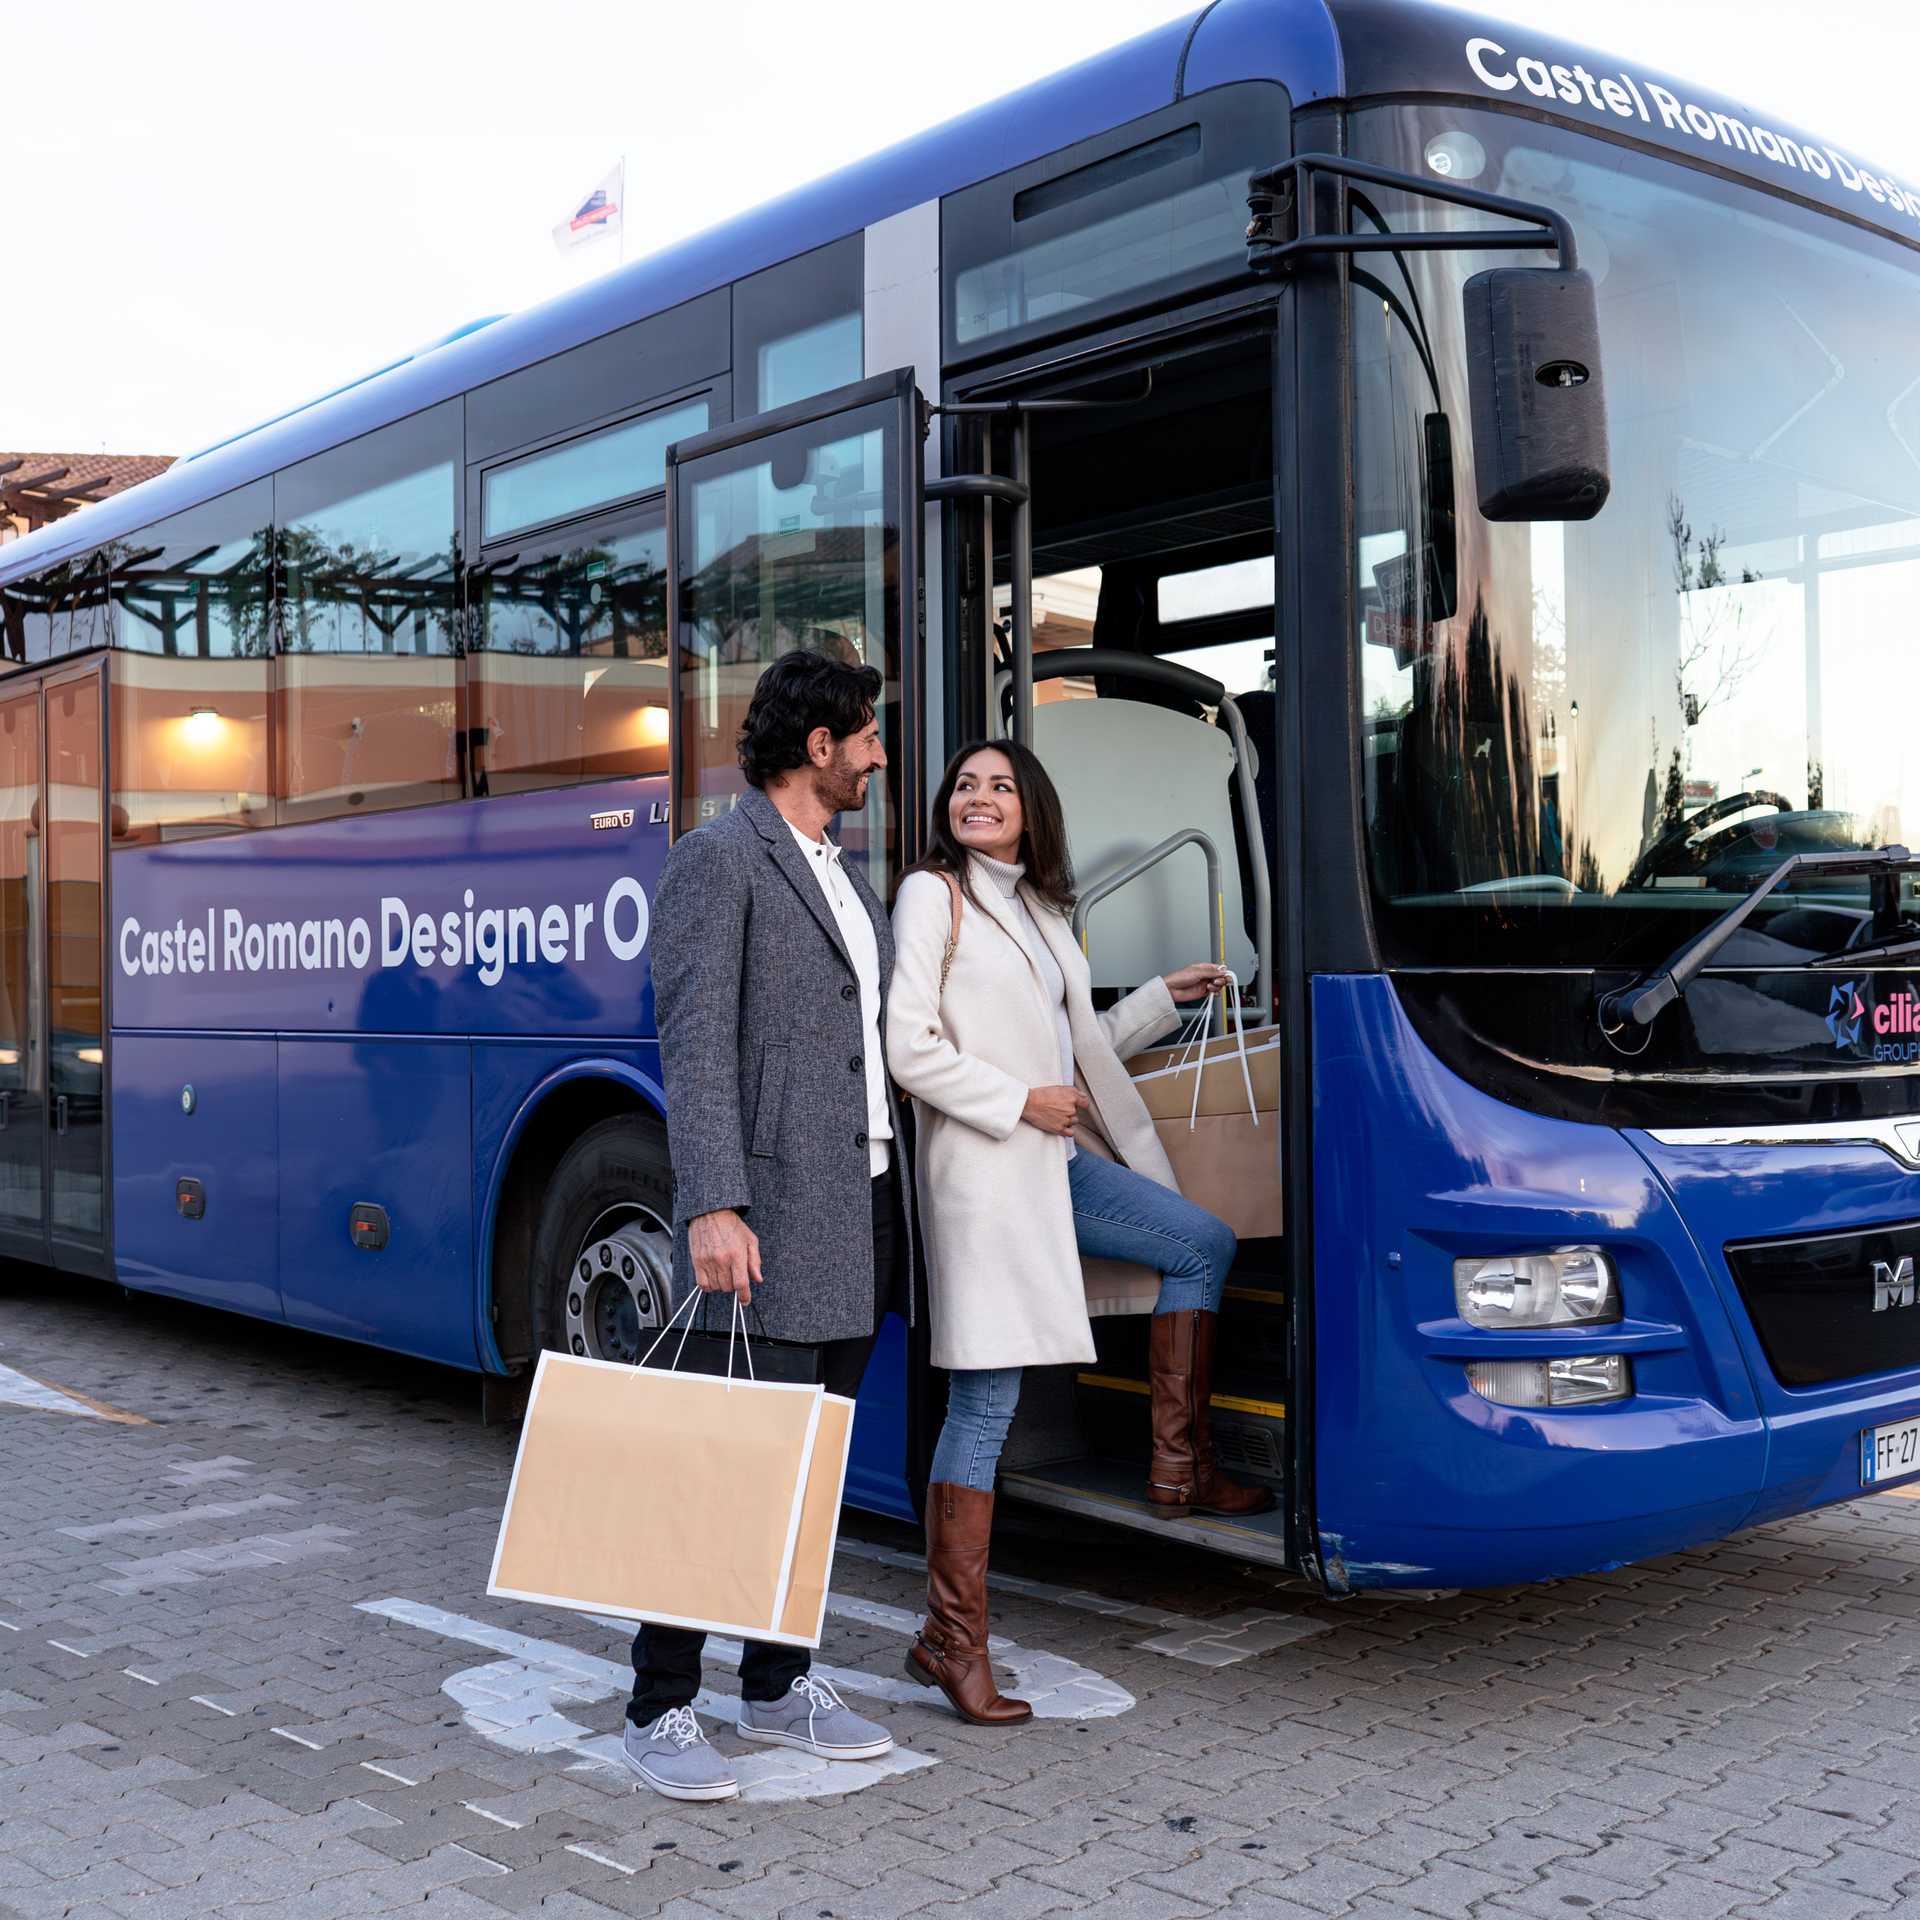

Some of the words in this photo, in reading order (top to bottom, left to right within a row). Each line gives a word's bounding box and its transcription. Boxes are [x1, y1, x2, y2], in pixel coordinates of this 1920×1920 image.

[1465, 37, 1650, 123] Castel
[1644, 81, 1830, 180] Romano
[593, 816, 618, 830] EURO
[118, 907, 216, 977] Castel
[223, 908, 371, 972] Romano
[381, 888, 594, 986] Designer
[603, 876, 650, 961] O
[1874, 1041, 1920, 1061] GROUP
[1871, 1256, 1920, 1312] M
